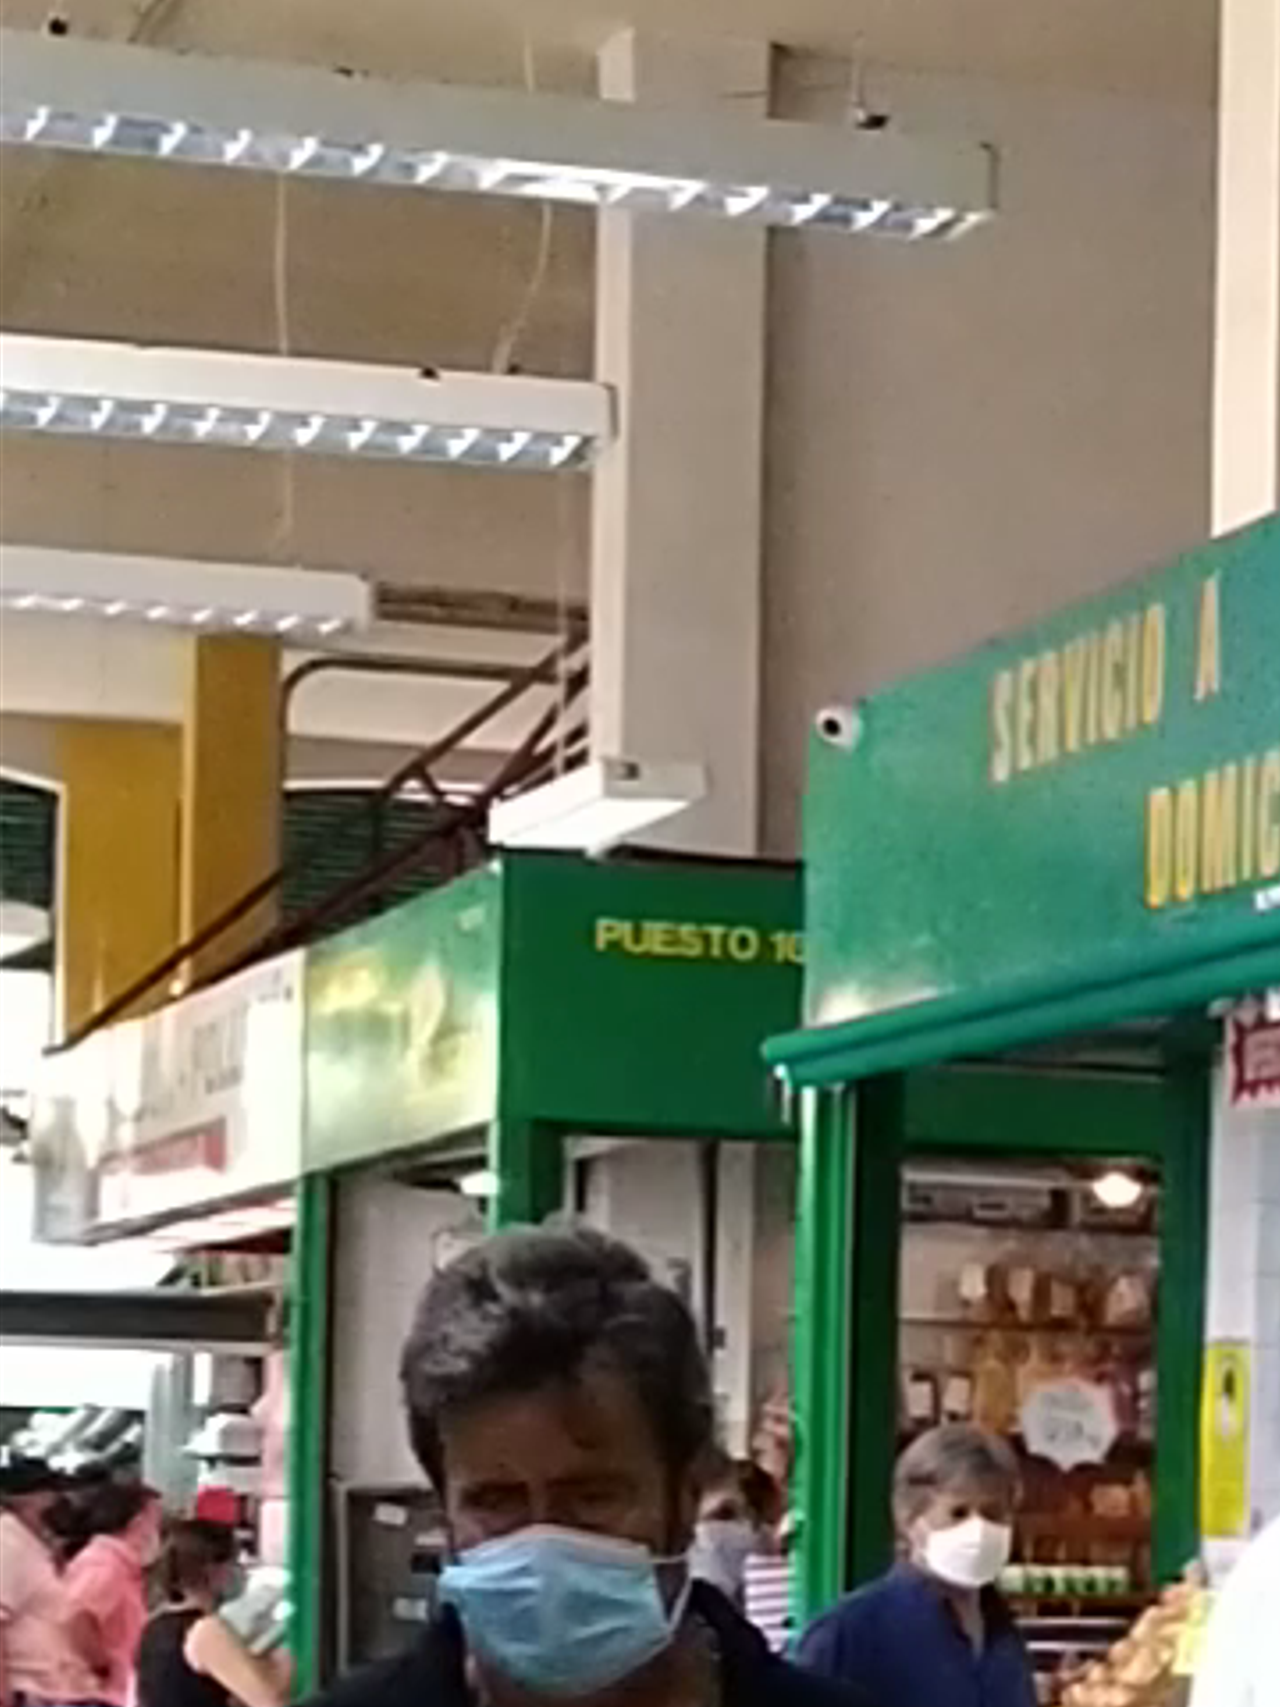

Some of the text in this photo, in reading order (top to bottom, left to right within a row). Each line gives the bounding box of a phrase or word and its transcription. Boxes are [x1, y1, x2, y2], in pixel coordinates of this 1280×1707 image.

[990, 569, 1220, 783] SERVICIO A
[595, 917, 759, 961] PUESTO
